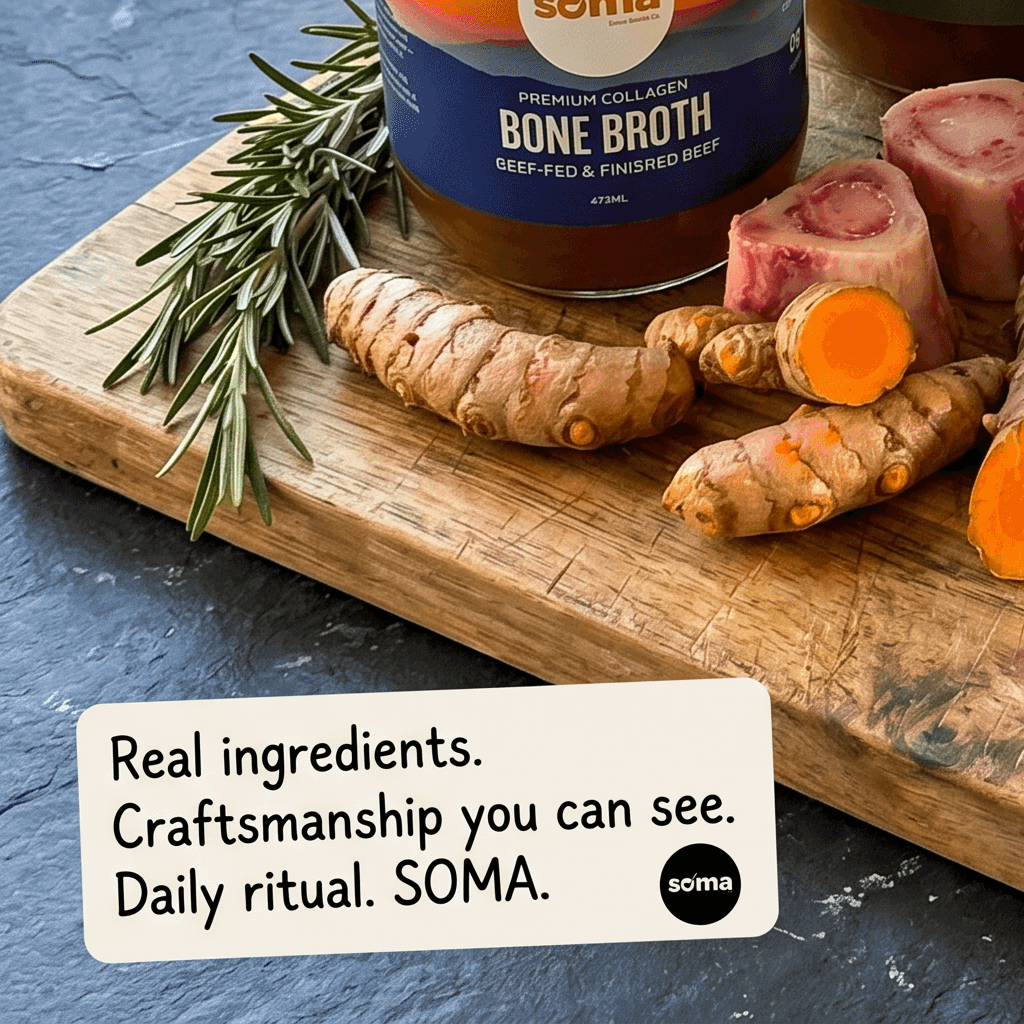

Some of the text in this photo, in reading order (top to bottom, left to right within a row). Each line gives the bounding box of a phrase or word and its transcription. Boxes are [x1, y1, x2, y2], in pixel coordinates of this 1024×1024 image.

[518, 78, 689, 107] PREMIUM COLLAGEN
[499, 91, 712, 156] BONE BROTH
[582, 165, 596, 178] &
[600, 153, 679, 177] FINISRED
[682, 137, 721, 163] BEEF
[590, 195, 629, 205] 473ML
